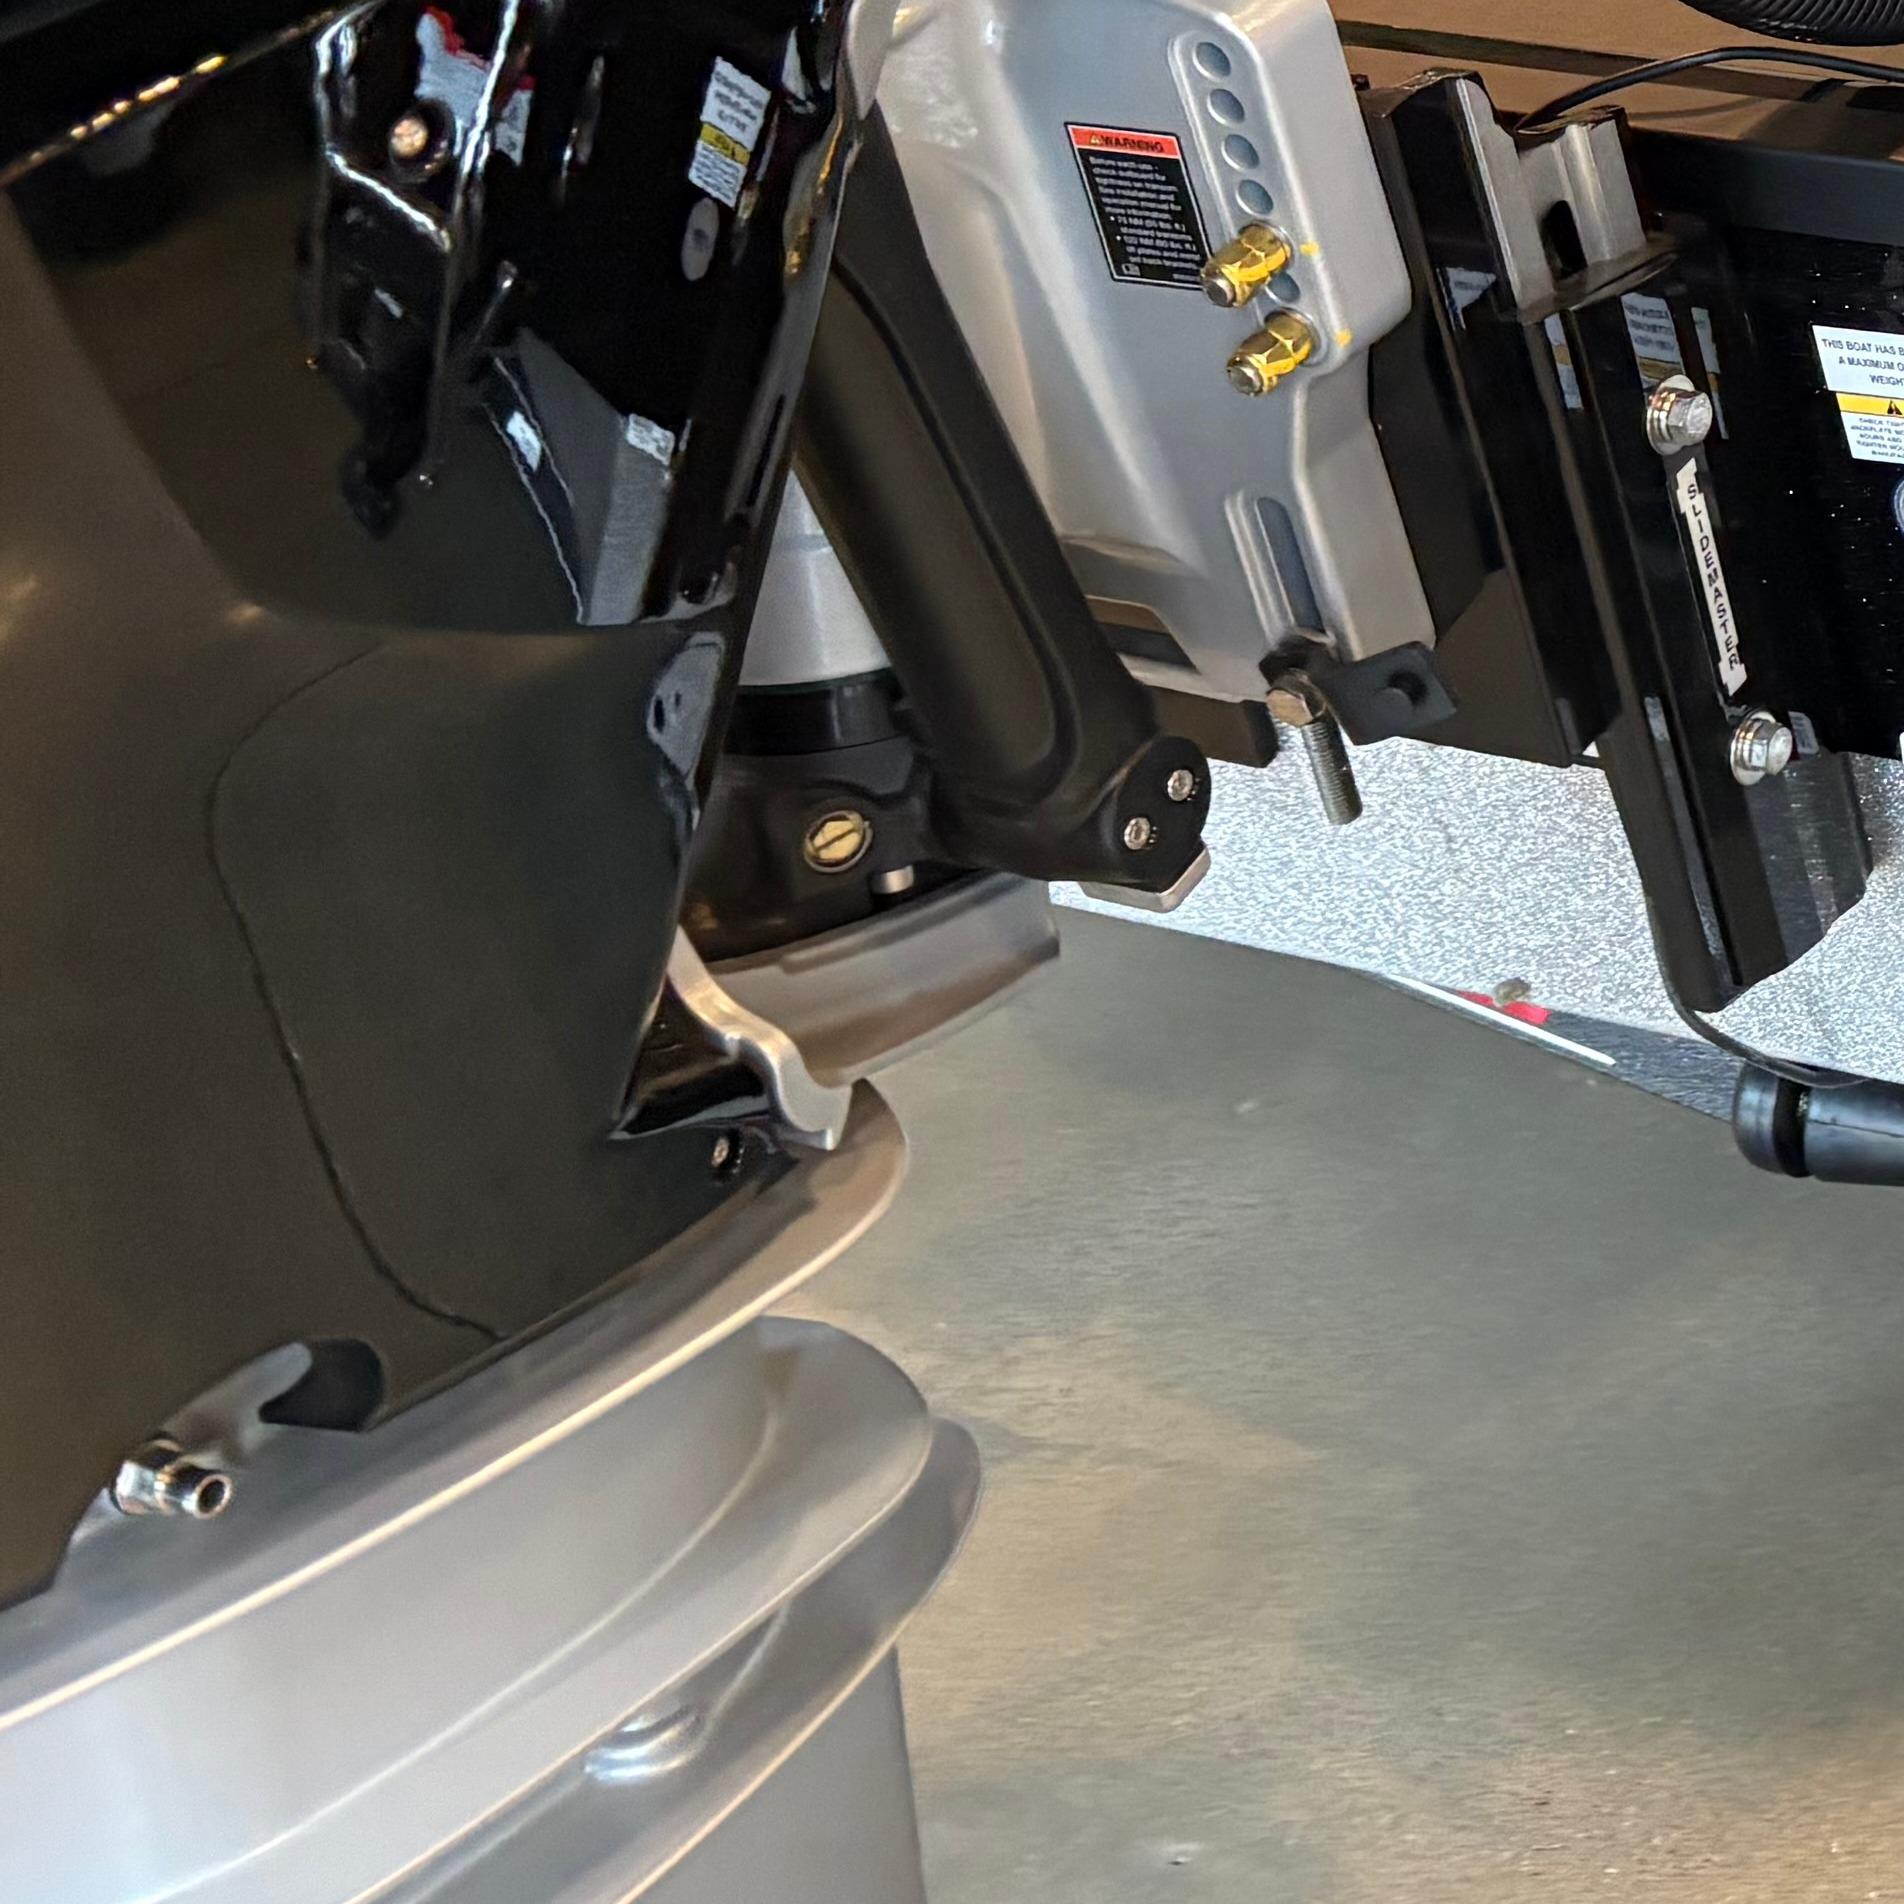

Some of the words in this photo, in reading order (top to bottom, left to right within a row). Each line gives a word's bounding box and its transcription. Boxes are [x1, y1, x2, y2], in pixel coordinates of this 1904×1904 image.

[1102, 135, 1164, 153] WARNING
[1821, 338, 1844, 350] THIS
[1846, 340, 1872, 353] BOAT
[1875, 344, 1896, 356] HAS
[1838, 356, 1846, 365] A
[1847, 357, 1895, 371] MAXIMUM
[1687, 483, 1740, 671] SLIDEMASTER
